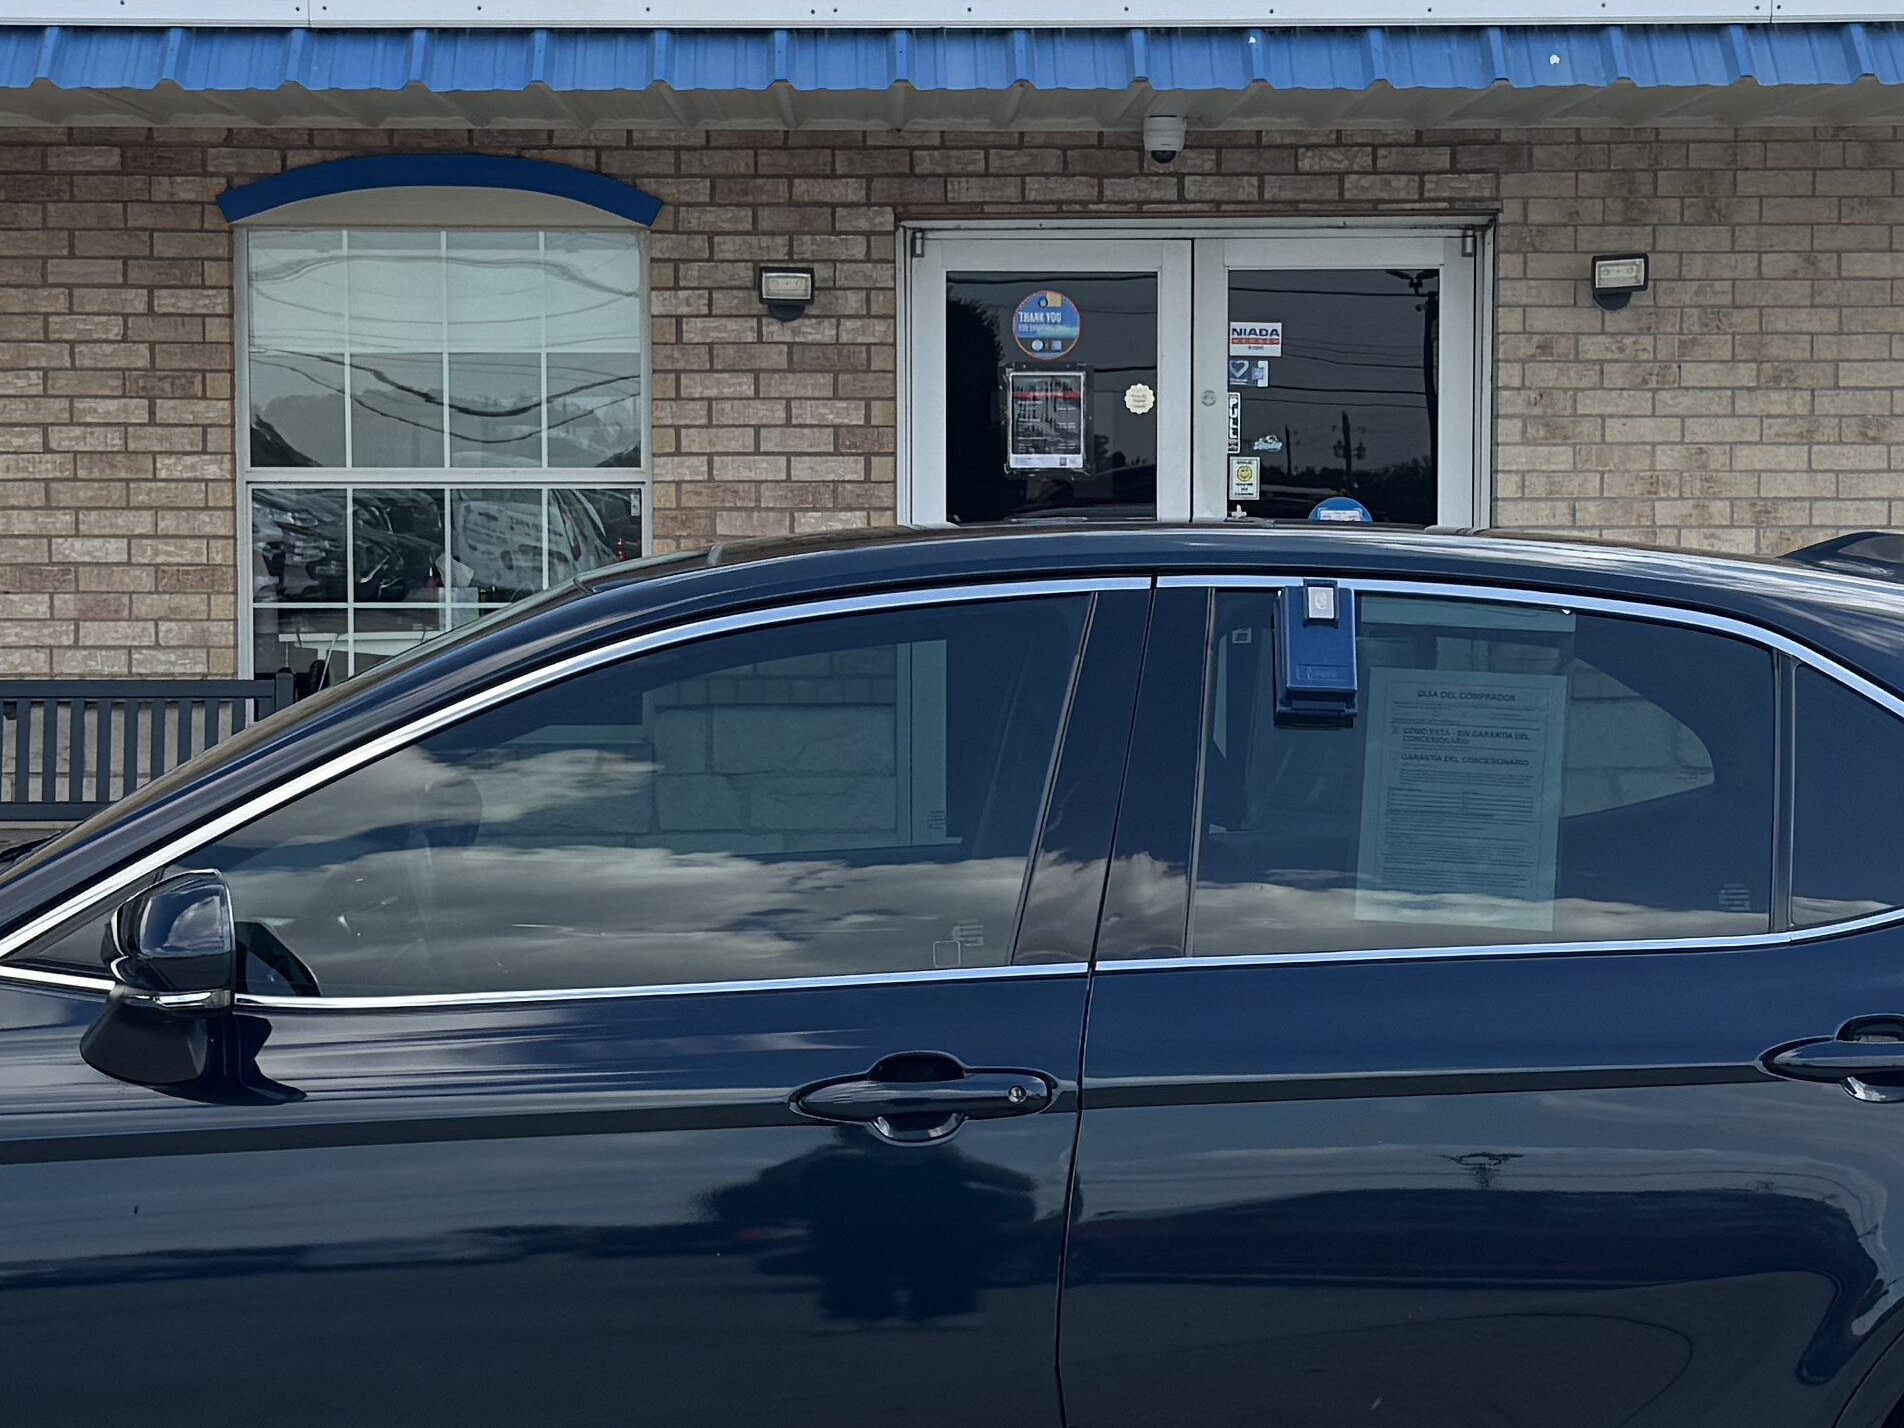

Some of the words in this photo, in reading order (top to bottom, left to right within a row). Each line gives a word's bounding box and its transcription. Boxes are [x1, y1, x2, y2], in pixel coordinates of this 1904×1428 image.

[1018, 312, 1045, 323] THANK
[1046, 312, 1062, 323] YOU
[1231, 328, 1280, 337] NIADA
